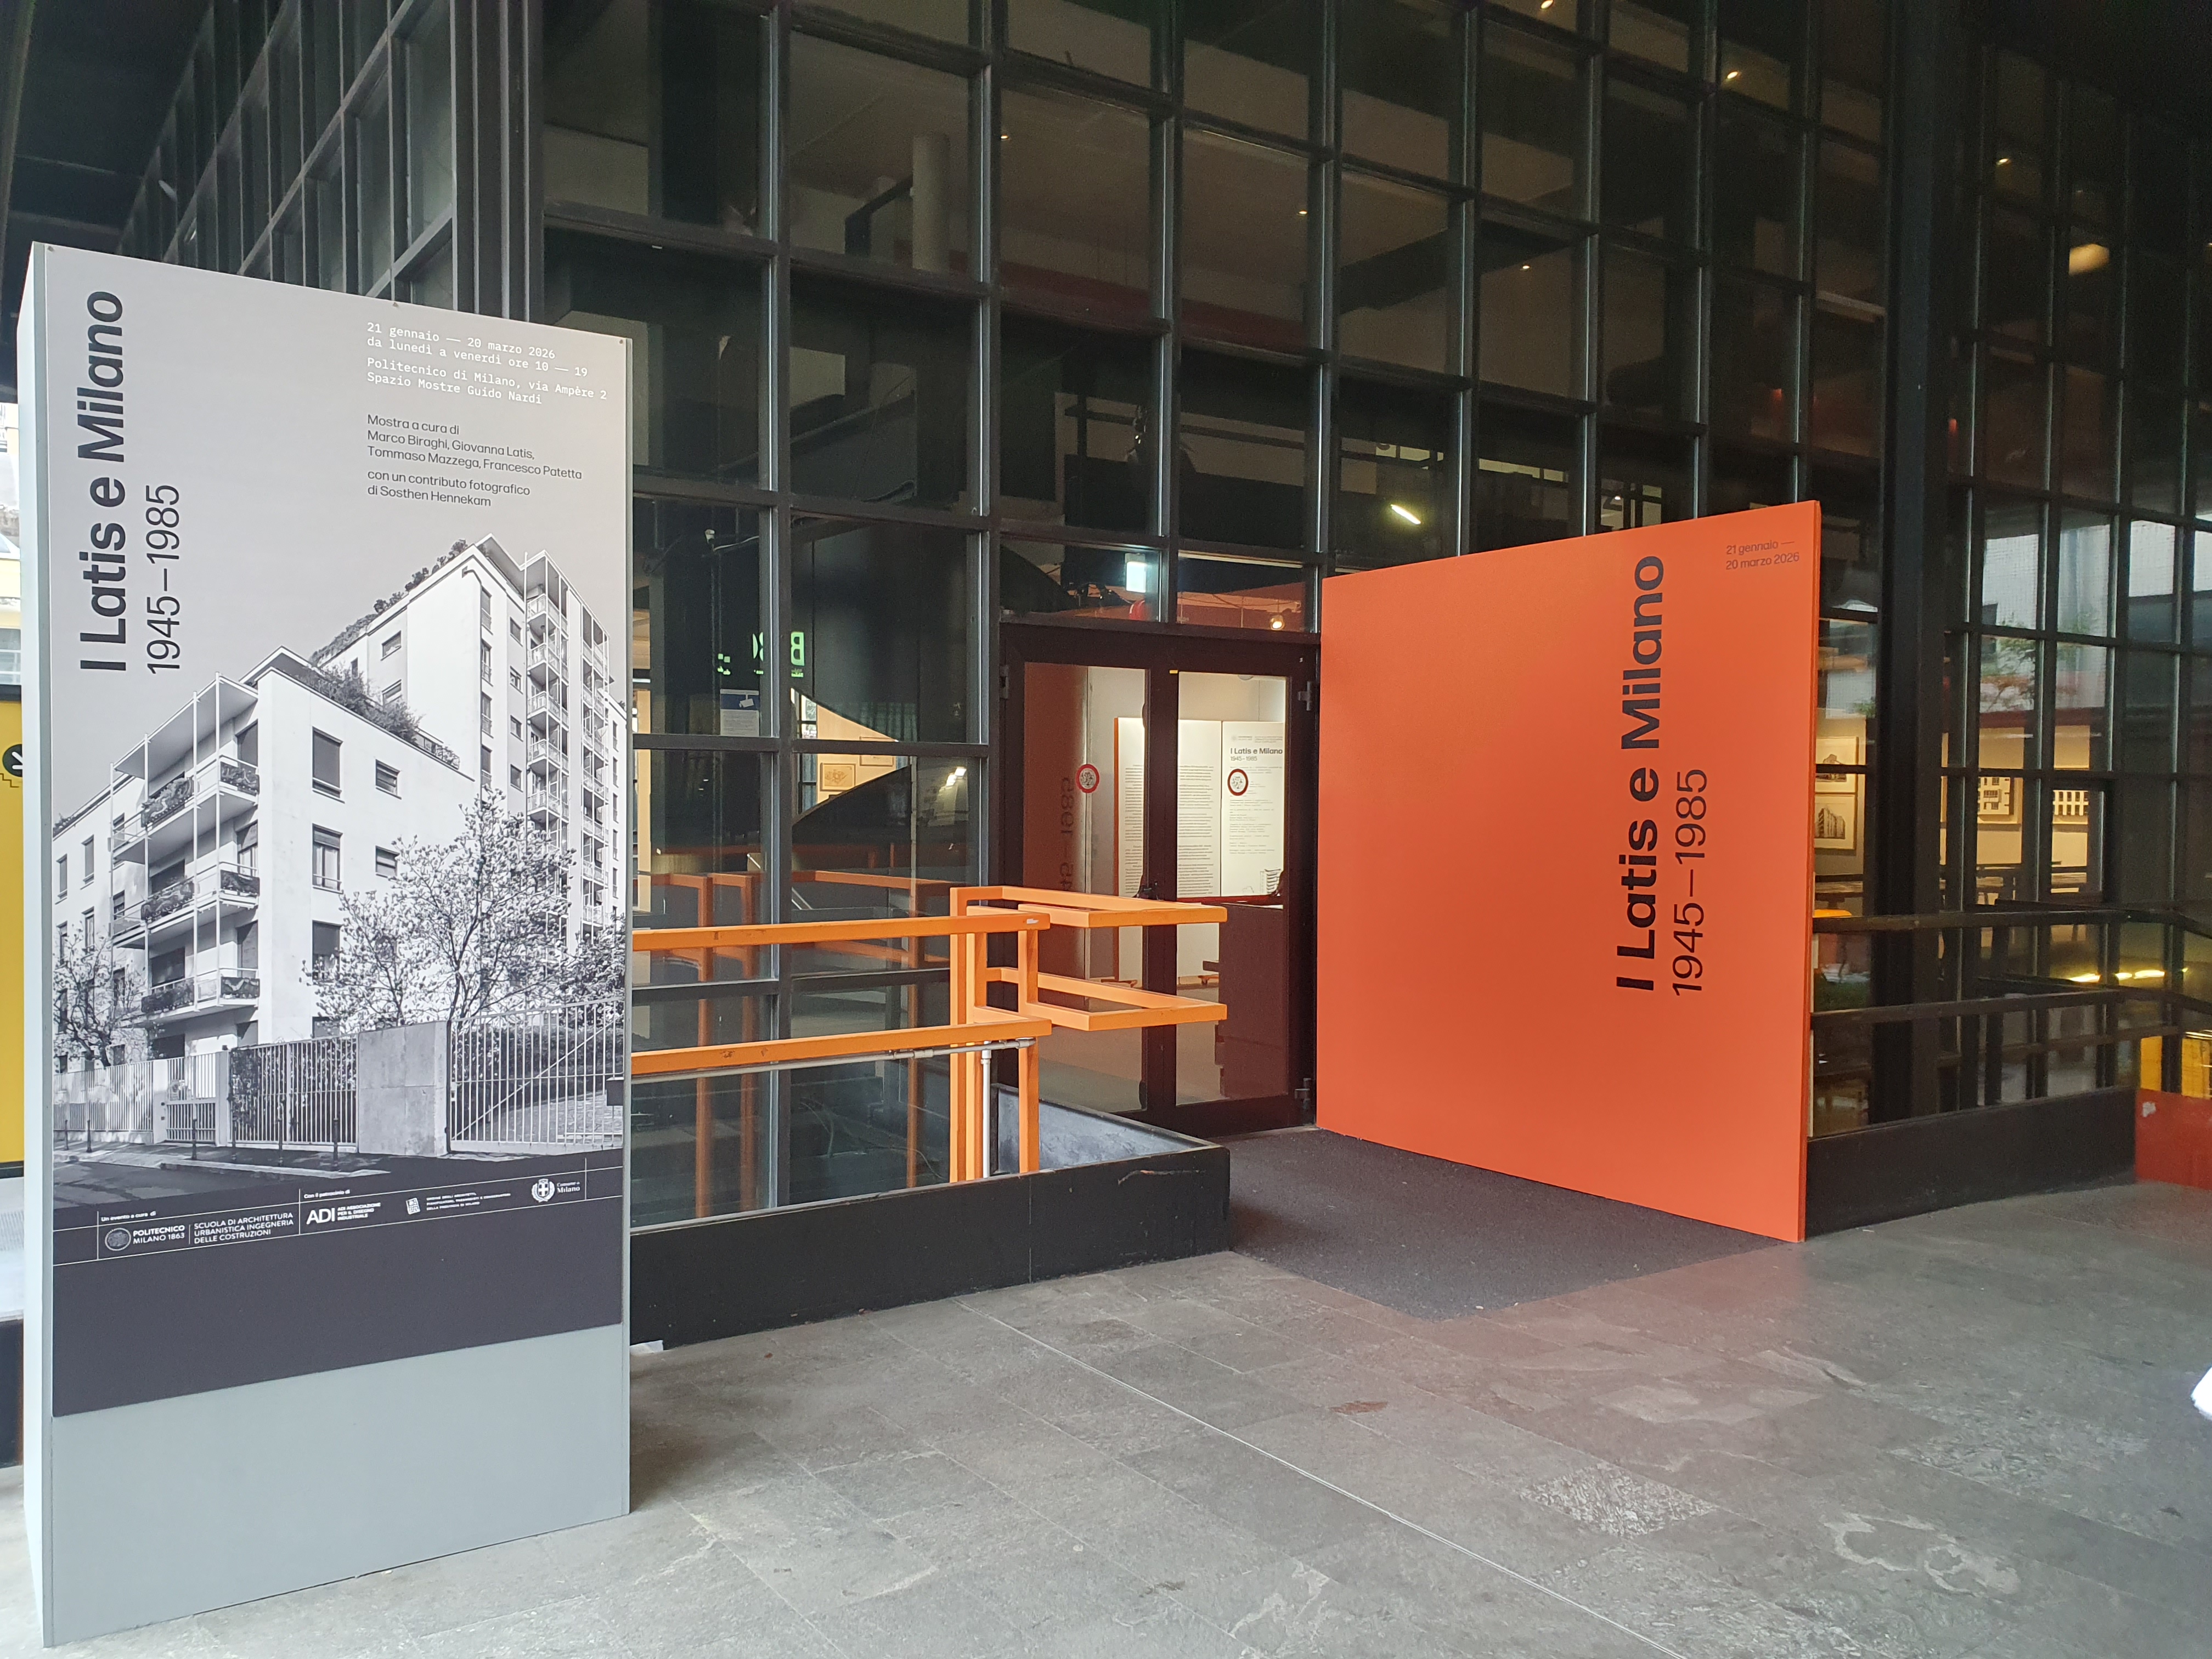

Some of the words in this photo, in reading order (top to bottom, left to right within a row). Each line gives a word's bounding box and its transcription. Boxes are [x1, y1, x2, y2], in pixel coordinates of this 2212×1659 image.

[367, 322, 381, 334] 21
[389, 327, 439, 342] gennaio
[467, 337, 482, 348] 20
[488, 342, 522, 354] marzo
[528, 347, 556, 359] 2026
[367, 336, 382, 348] da
[439, 348, 447, 357] a
[508, 358, 529, 369] ore
[535, 361, 549, 371] 10
[574, 366, 588, 377] 19
[76, 291, 125, 462] Milano
[367, 358, 447, 377] Politecnico
[453, 370, 468, 381] di
[474, 373, 521, 389] Milano,
[528, 380, 549, 392] via
[555, 384, 594, 398] Ampère
[600, 390, 607, 399] 2
[367, 371, 411, 387] Spazio
[418, 379, 461, 393] Mostre
[467, 385, 502, 399] Guido
[509, 392, 542, 404] Nardi
[368, 414, 410, 429] Mostra
[412, 421, 419, 430] a
[421, 423, 448, 434] cura
[449, 425, 459, 435] di
[368, 430, 405, 444] Marco
[408, 435, 450, 451] Biraghi,
[452, 440, 505, 455] Giovanna
[506, 446, 535, 460] Latis,
[368, 445, 426, 462] Tommaso
[428, 452, 481, 469] Mazzega,
[483, 459, 541, 475] Francesco
[543, 466, 582, 479] Patetta
[89, 477, 126, 508] e
[368, 471, 390, 481] con
[392, 473, 406, 482] un
[408, 474, 467, 489] contributo
[469, 480, 531, 496] fotografico
[368, 485, 378, 495] di
[380, 486, 429, 500] Sosthen
[431, 492, 492, 506] Hennekam
[1726, 545, 1736, 555] 21
[1738, 540, 1779, 555] gennaio
[1726, 559, 1738, 570] 20
[1740, 557, 1771, 568] marzo
[1774, 552, 1799, 564] 2026
[80, 522, 126, 644] Latis
[1620, 555, 1664, 750] Milano
[80, 660, 126, 672] I
[1629, 766, 1660, 803] e
[1616, 819, 1658, 961] Latis
[1616, 975, 1654, 992] I
[194, 1220, 226, 1229] SCUOLA
[237, 1212, 294, 1224] ARCHITETTURA
[194, 1225, 245, 1237] URBANISTICA
[247, 1219, 294, 1230] INGEGNERIA
[306, 1207, 335, 1224] ADI
[133, 1224, 185, 1237] POLITECNICO
[133, 1235, 166, 1244] MILANO
[194, 1235, 218, 1244] DELLE
[219, 1229, 271, 1241] COSTRUZIONI
